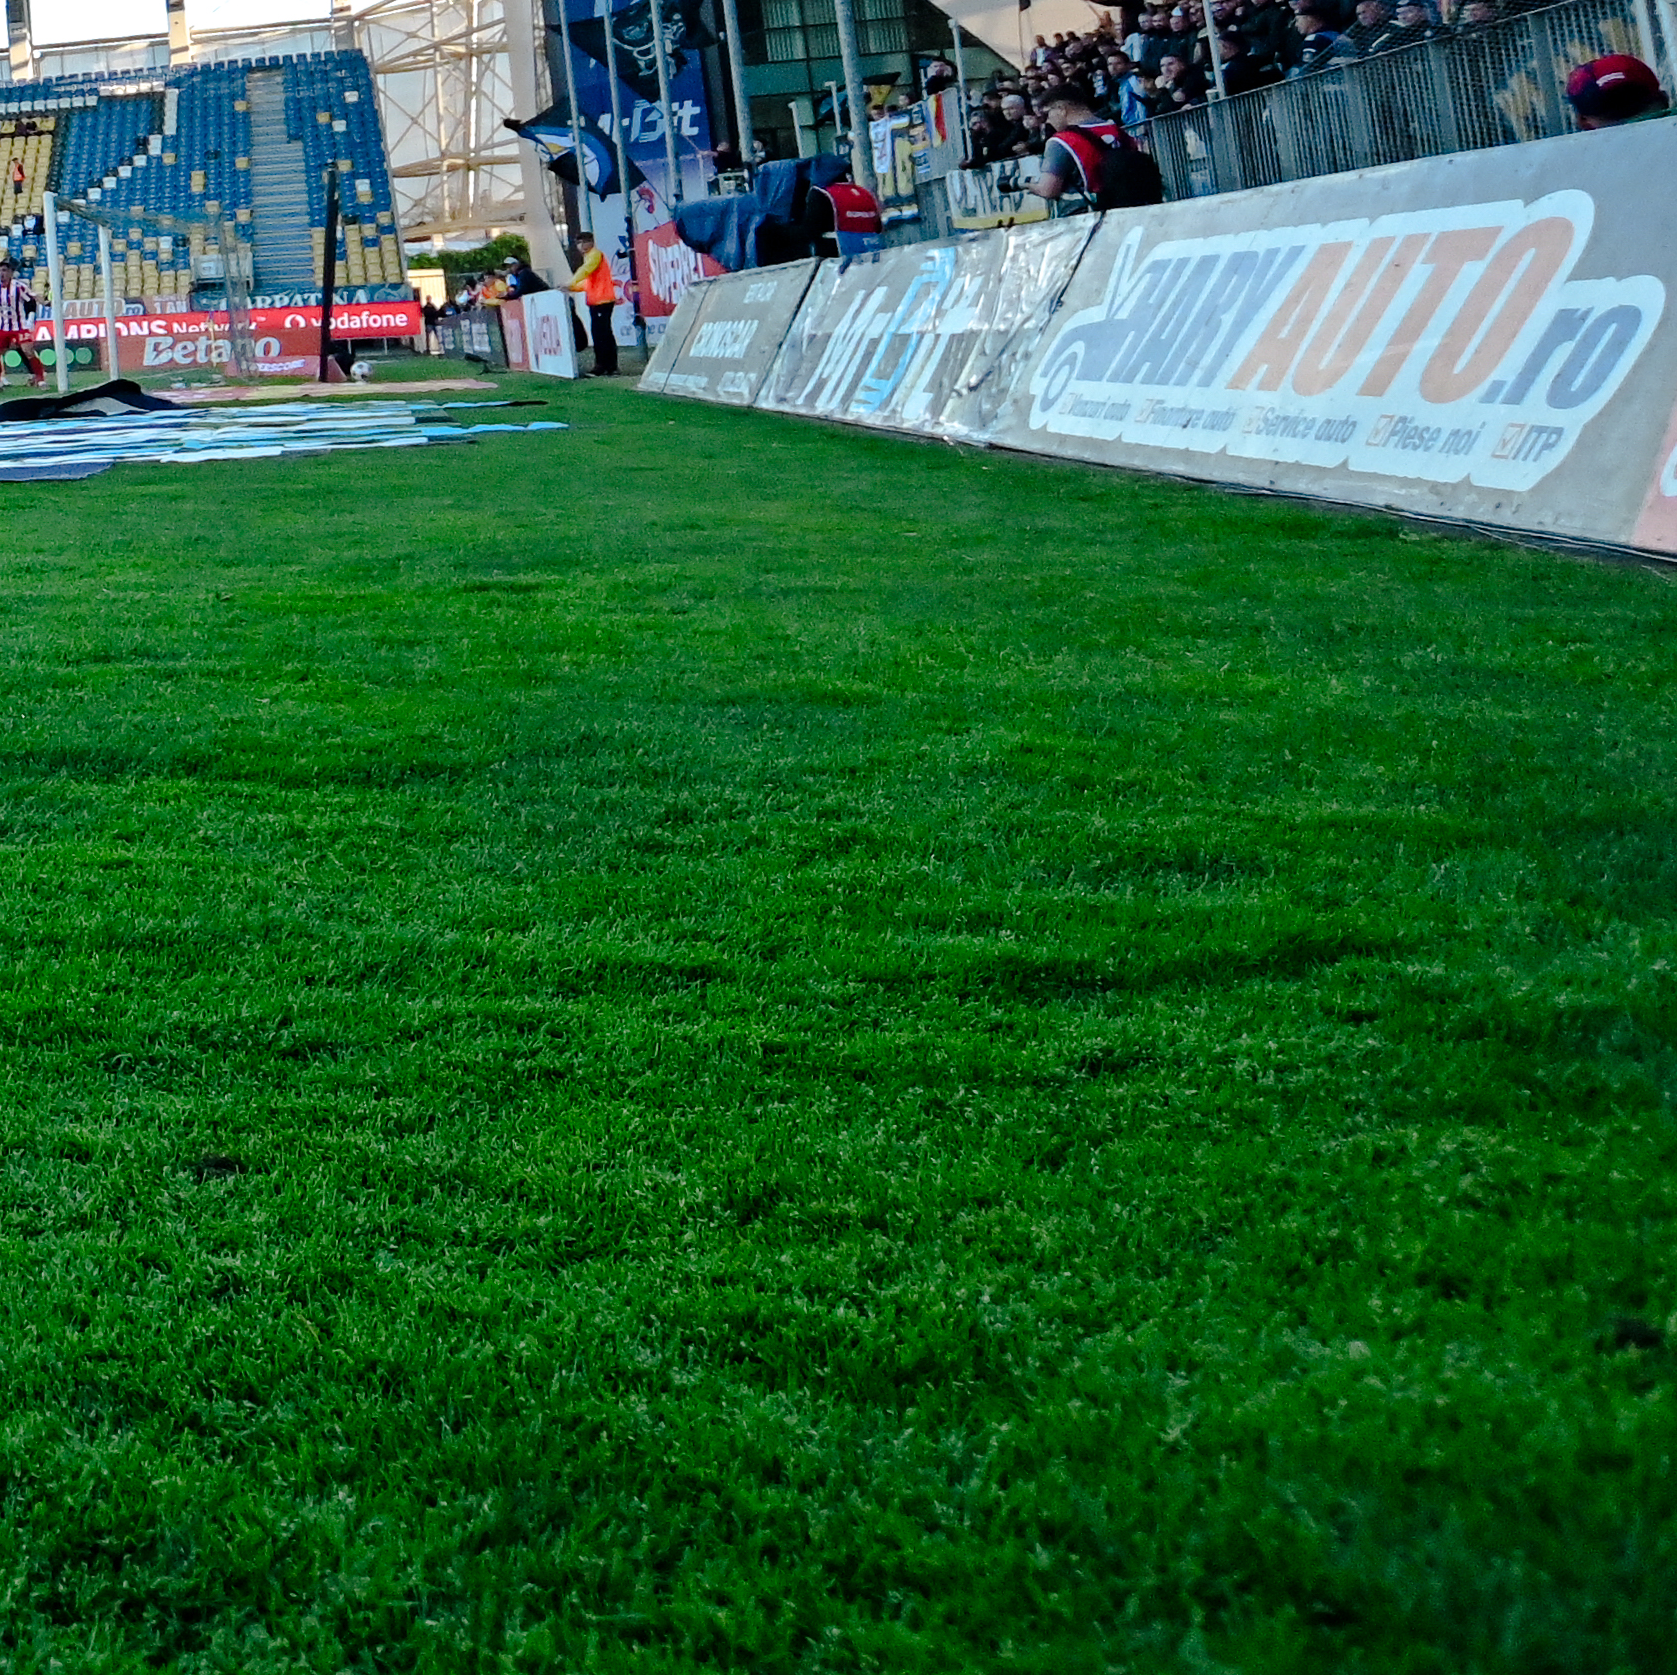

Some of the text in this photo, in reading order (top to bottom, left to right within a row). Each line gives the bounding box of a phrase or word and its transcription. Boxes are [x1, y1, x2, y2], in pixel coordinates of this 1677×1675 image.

[1257, 406, 1358, 444] Service auto
[1382, 415, 1487, 456] Piese noi
[1512, 424, 1565, 463] ITP
